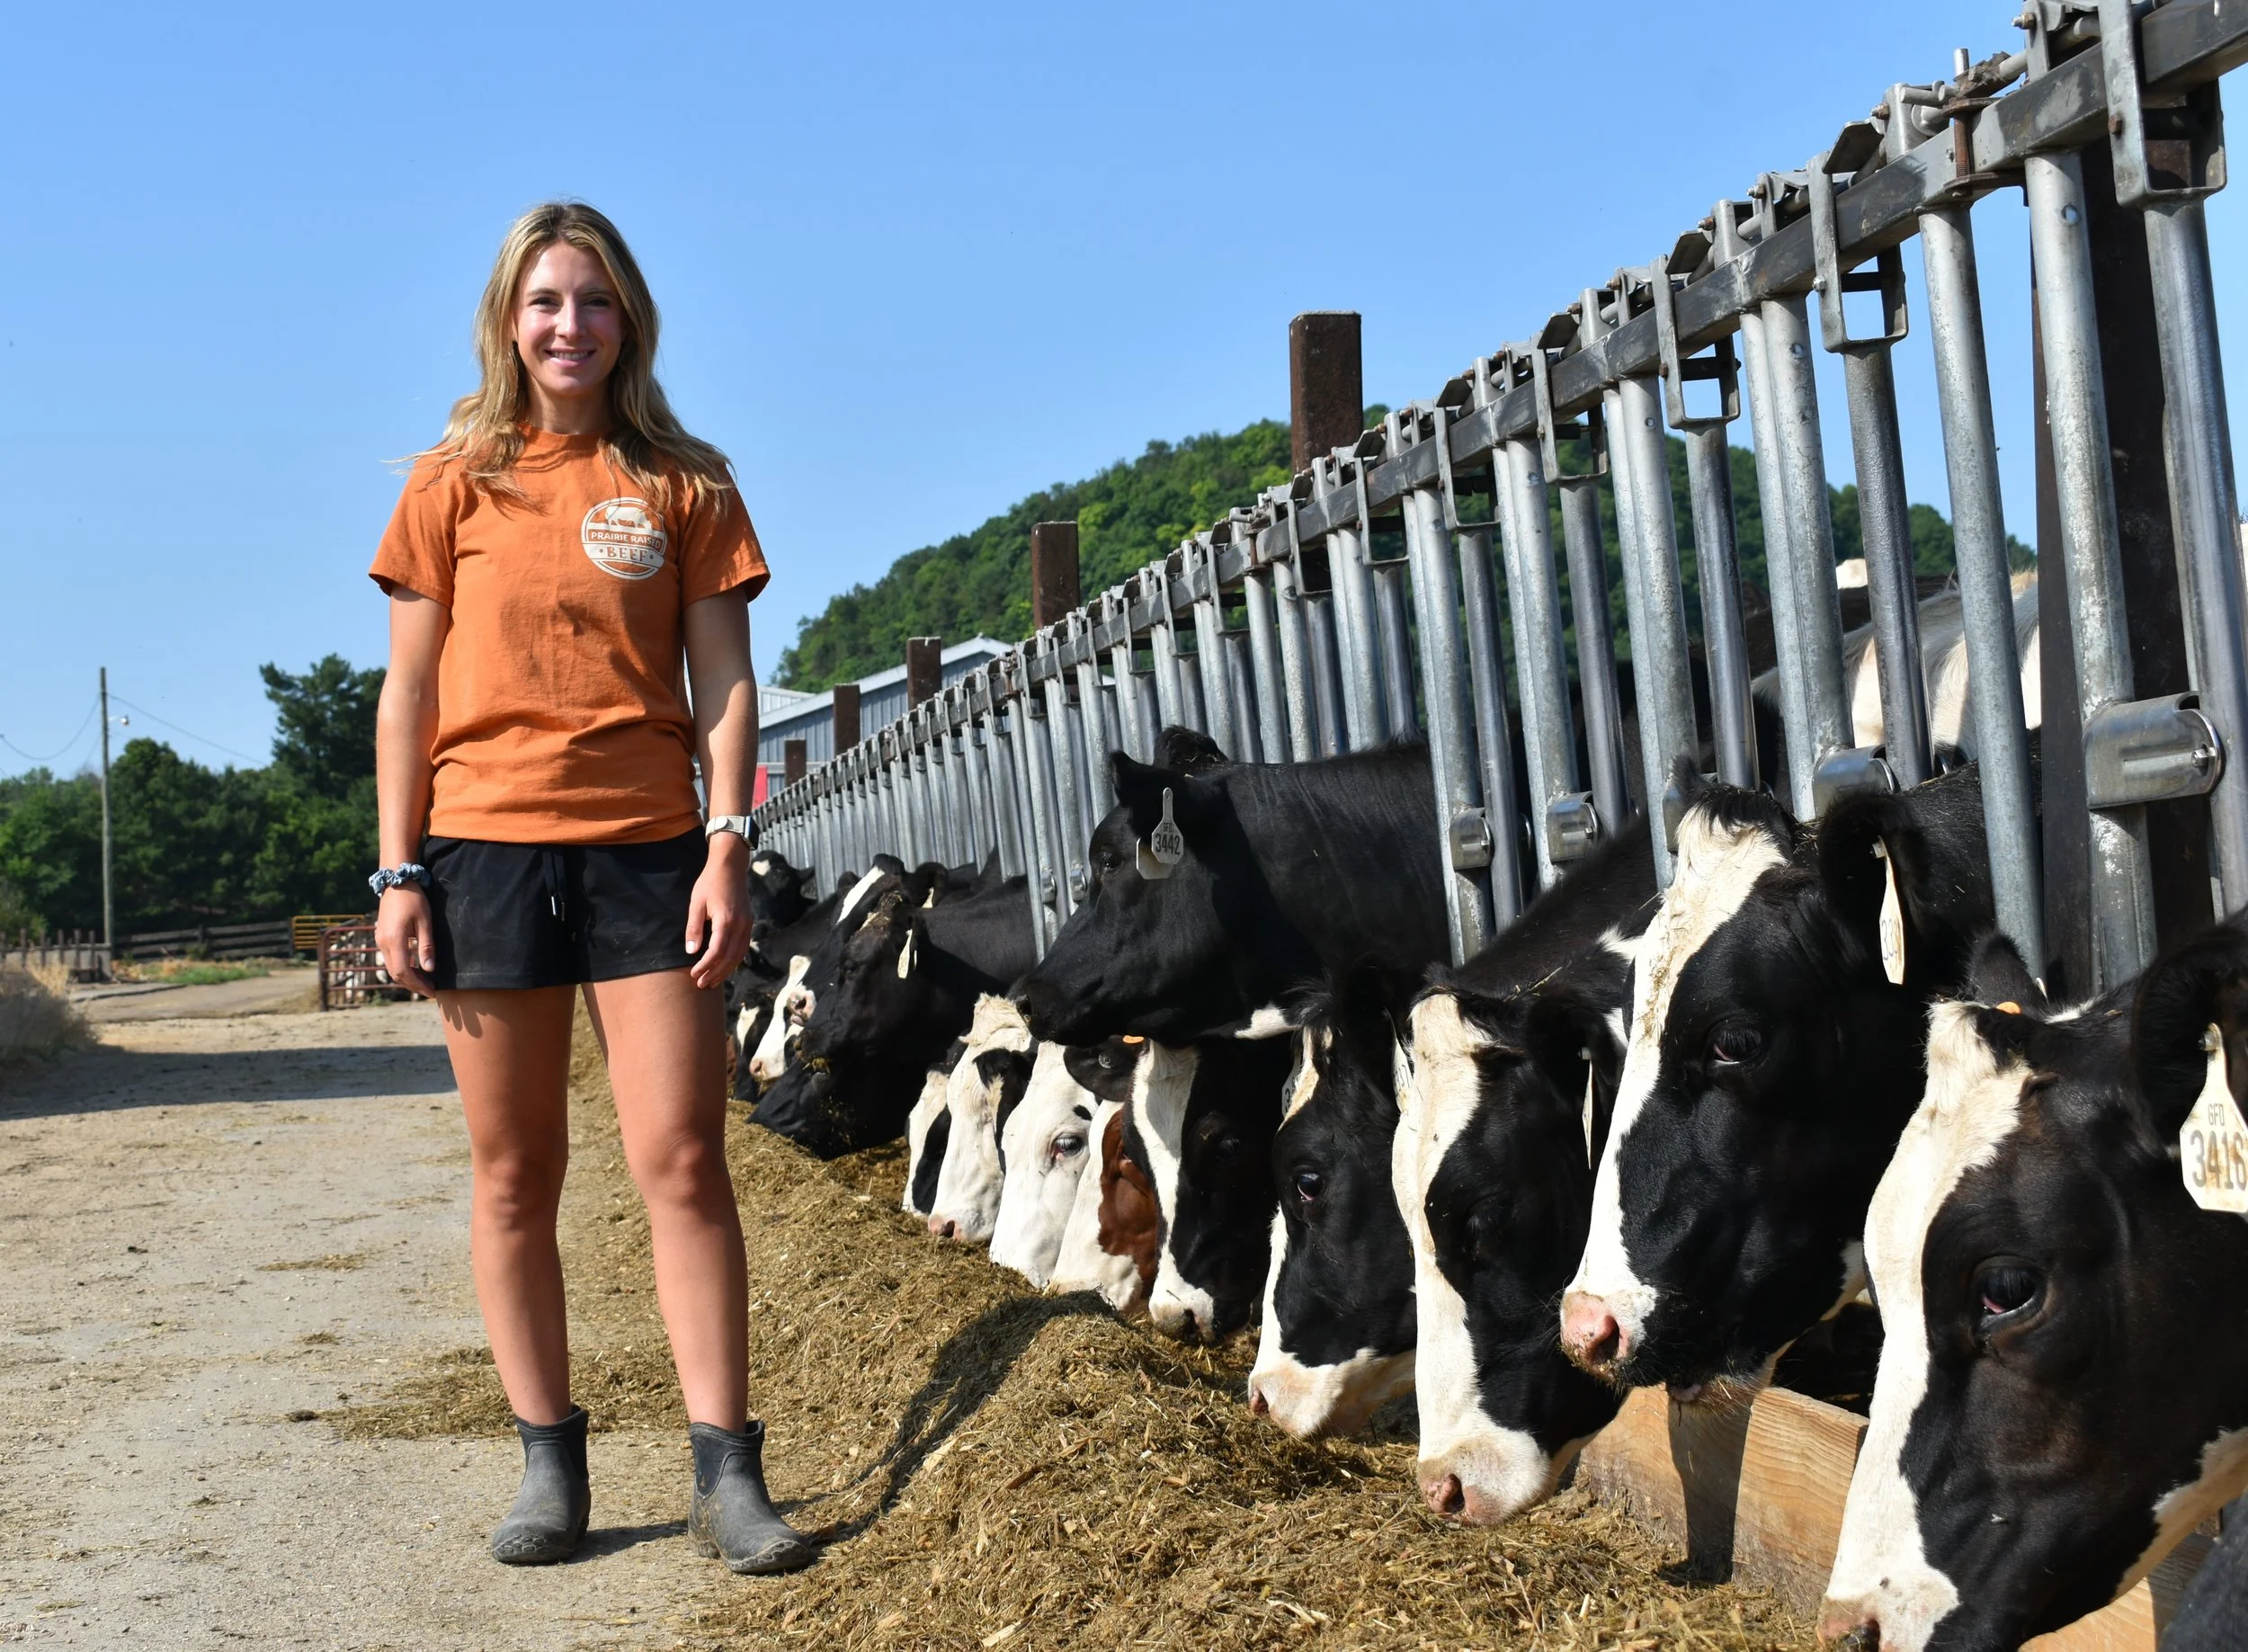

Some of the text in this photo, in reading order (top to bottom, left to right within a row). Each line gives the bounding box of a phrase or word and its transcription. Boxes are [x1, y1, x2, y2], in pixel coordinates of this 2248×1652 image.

[591, 531, 661, 548] PRAIRIE RAISED
[606, 546, 647, 561] BEEF
[1155, 833, 1180, 855] 3442
[2208, 1103, 2225, 1126] GFD
[2190, 1130, 2247, 1192] 3416
